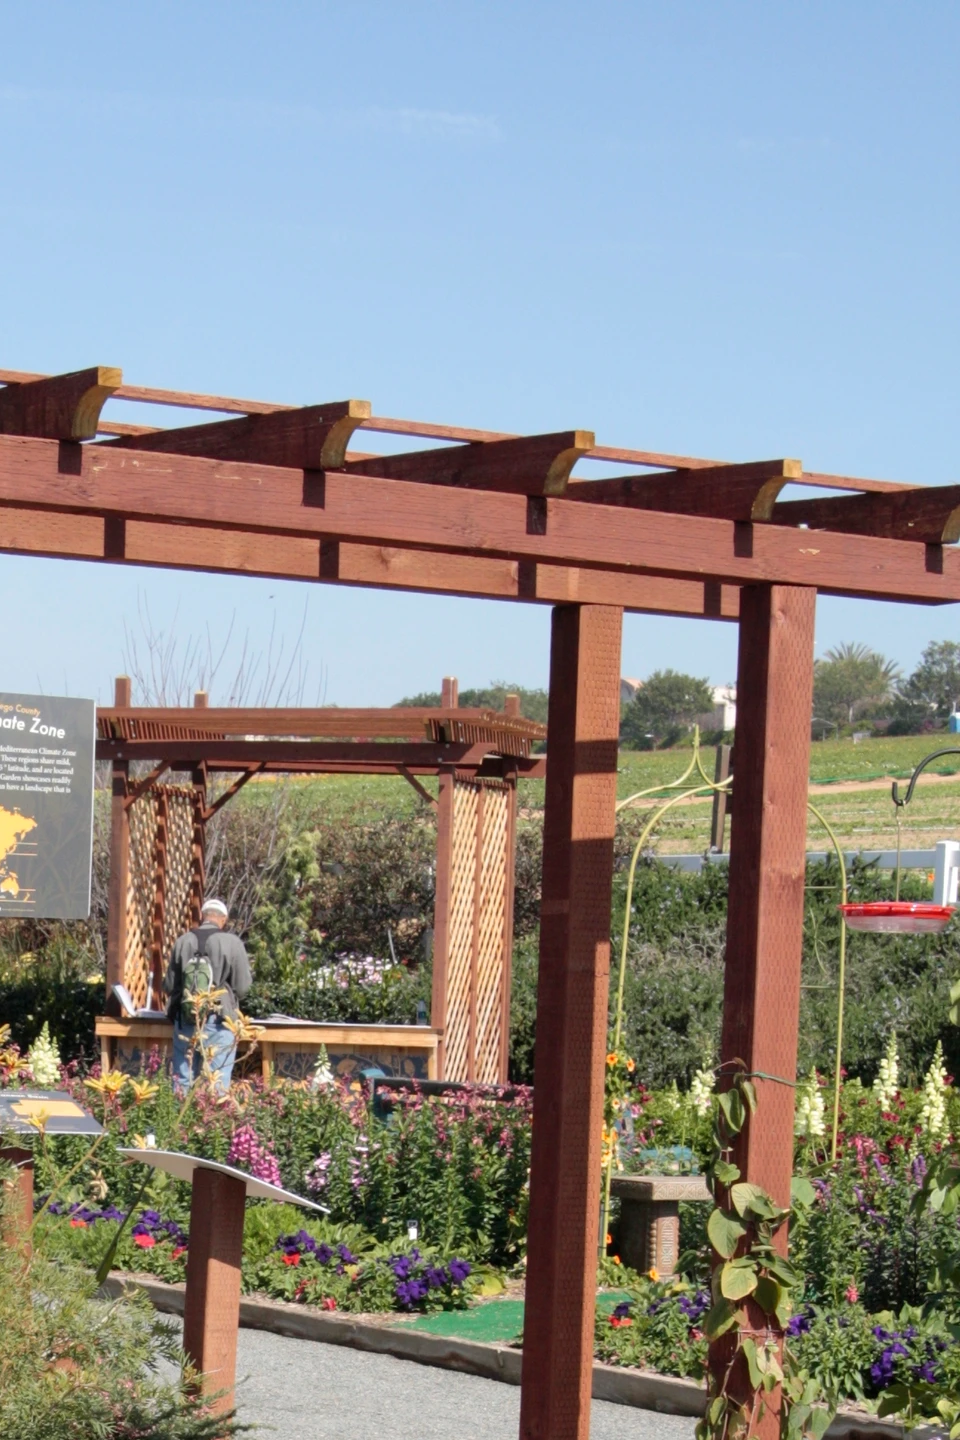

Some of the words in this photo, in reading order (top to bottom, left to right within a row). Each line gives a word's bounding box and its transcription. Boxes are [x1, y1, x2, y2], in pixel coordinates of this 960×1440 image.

[16, 704, 40, 717] County
[30, 718, 65, 738] Zone
[19, 756, 38, 765] regions
[41, 756, 55, 764] share
[54, 767, 73, 775] located
[0, 773, 21, 781] Garden
[23, 775, 50, 783] showcases
[52, 777, 71, 785] readily
[25, 784, 52, 793] landscape
